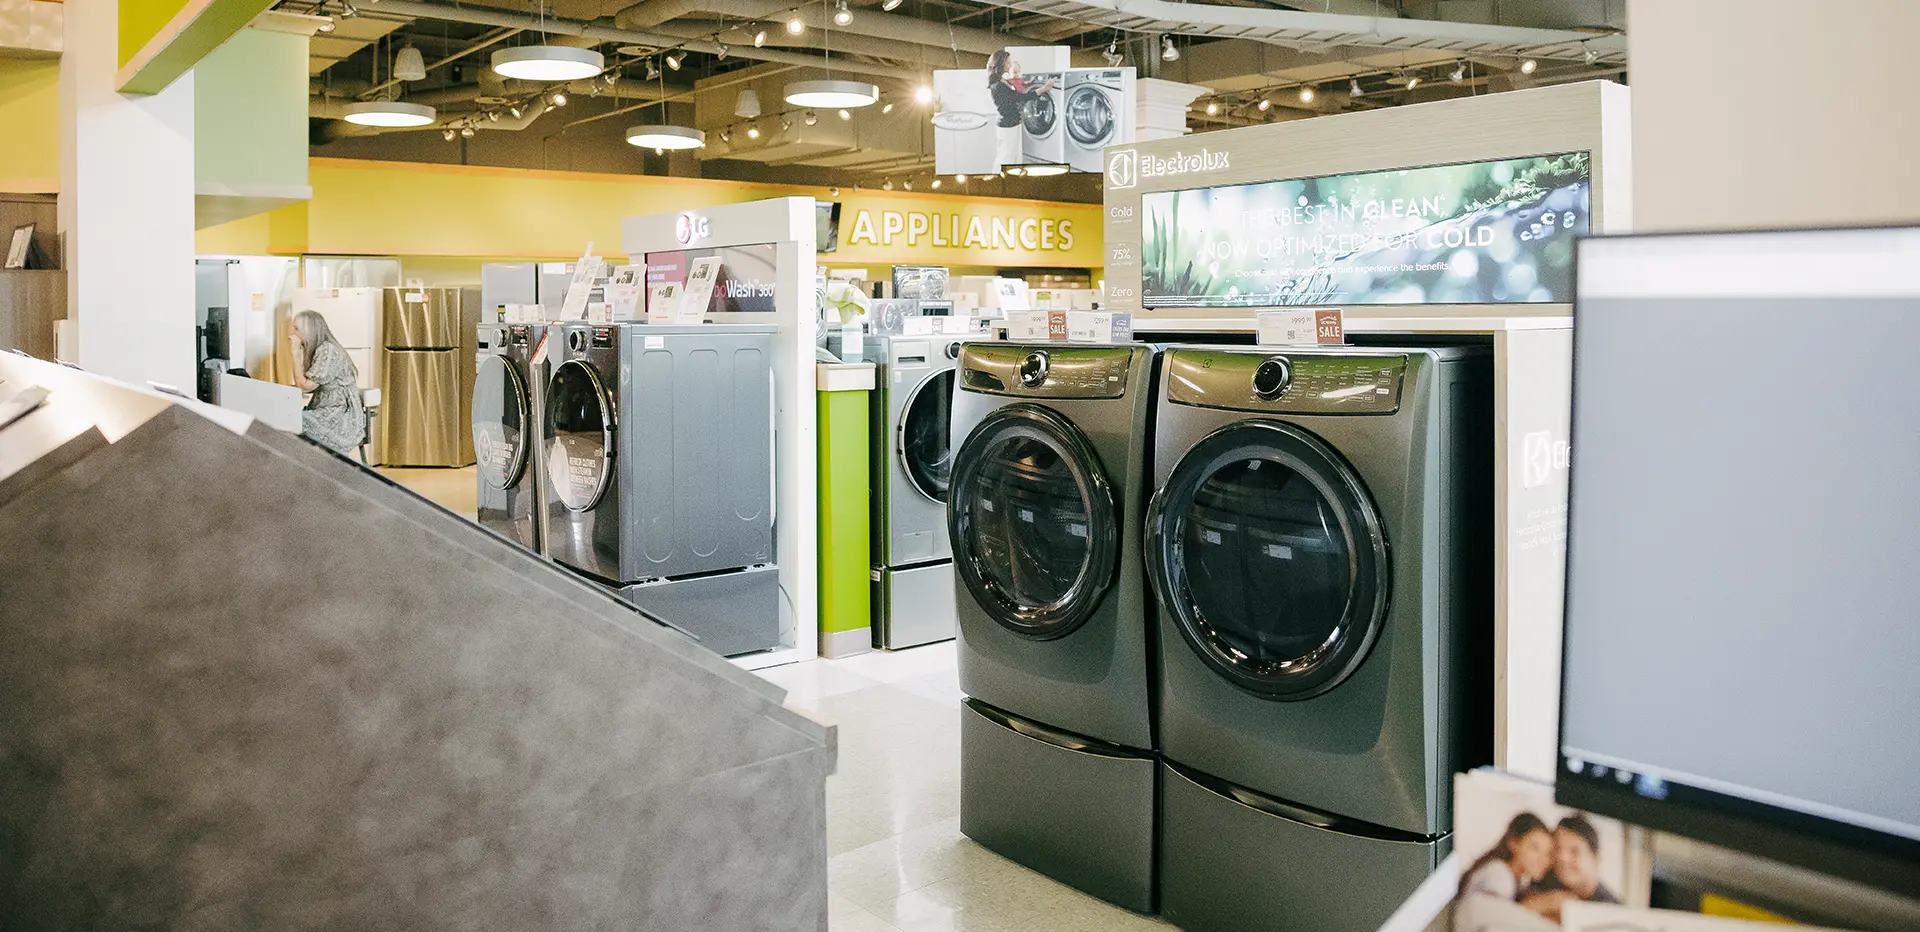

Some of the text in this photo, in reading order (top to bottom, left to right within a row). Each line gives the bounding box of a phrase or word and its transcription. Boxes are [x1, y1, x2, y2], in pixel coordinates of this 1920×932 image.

[1140, 148, 1231, 177] Electrolux
[1111, 206, 1133, 217] Cold
[1240, 208, 1274, 229] THE
[1281, 204, 1326, 226] BEST
[1333, 203, 1355, 222] IN
[692, 215, 711, 238] LG
[848, 209, 1074, 250] APPLIANCES
[1204, 225, 1496, 260] NOW OPTIMIZED FOR COLD
[1112, 249, 1131, 260] 75%
[1339, 264, 1353, 275] and
[1355, 264, 1398, 276] experience
[1400, 263, 1414, 273] the
[1111, 287, 1133, 297] Zero
[1050, 325, 1065, 335] SALE
[1319, 326, 1340, 338] SALE
